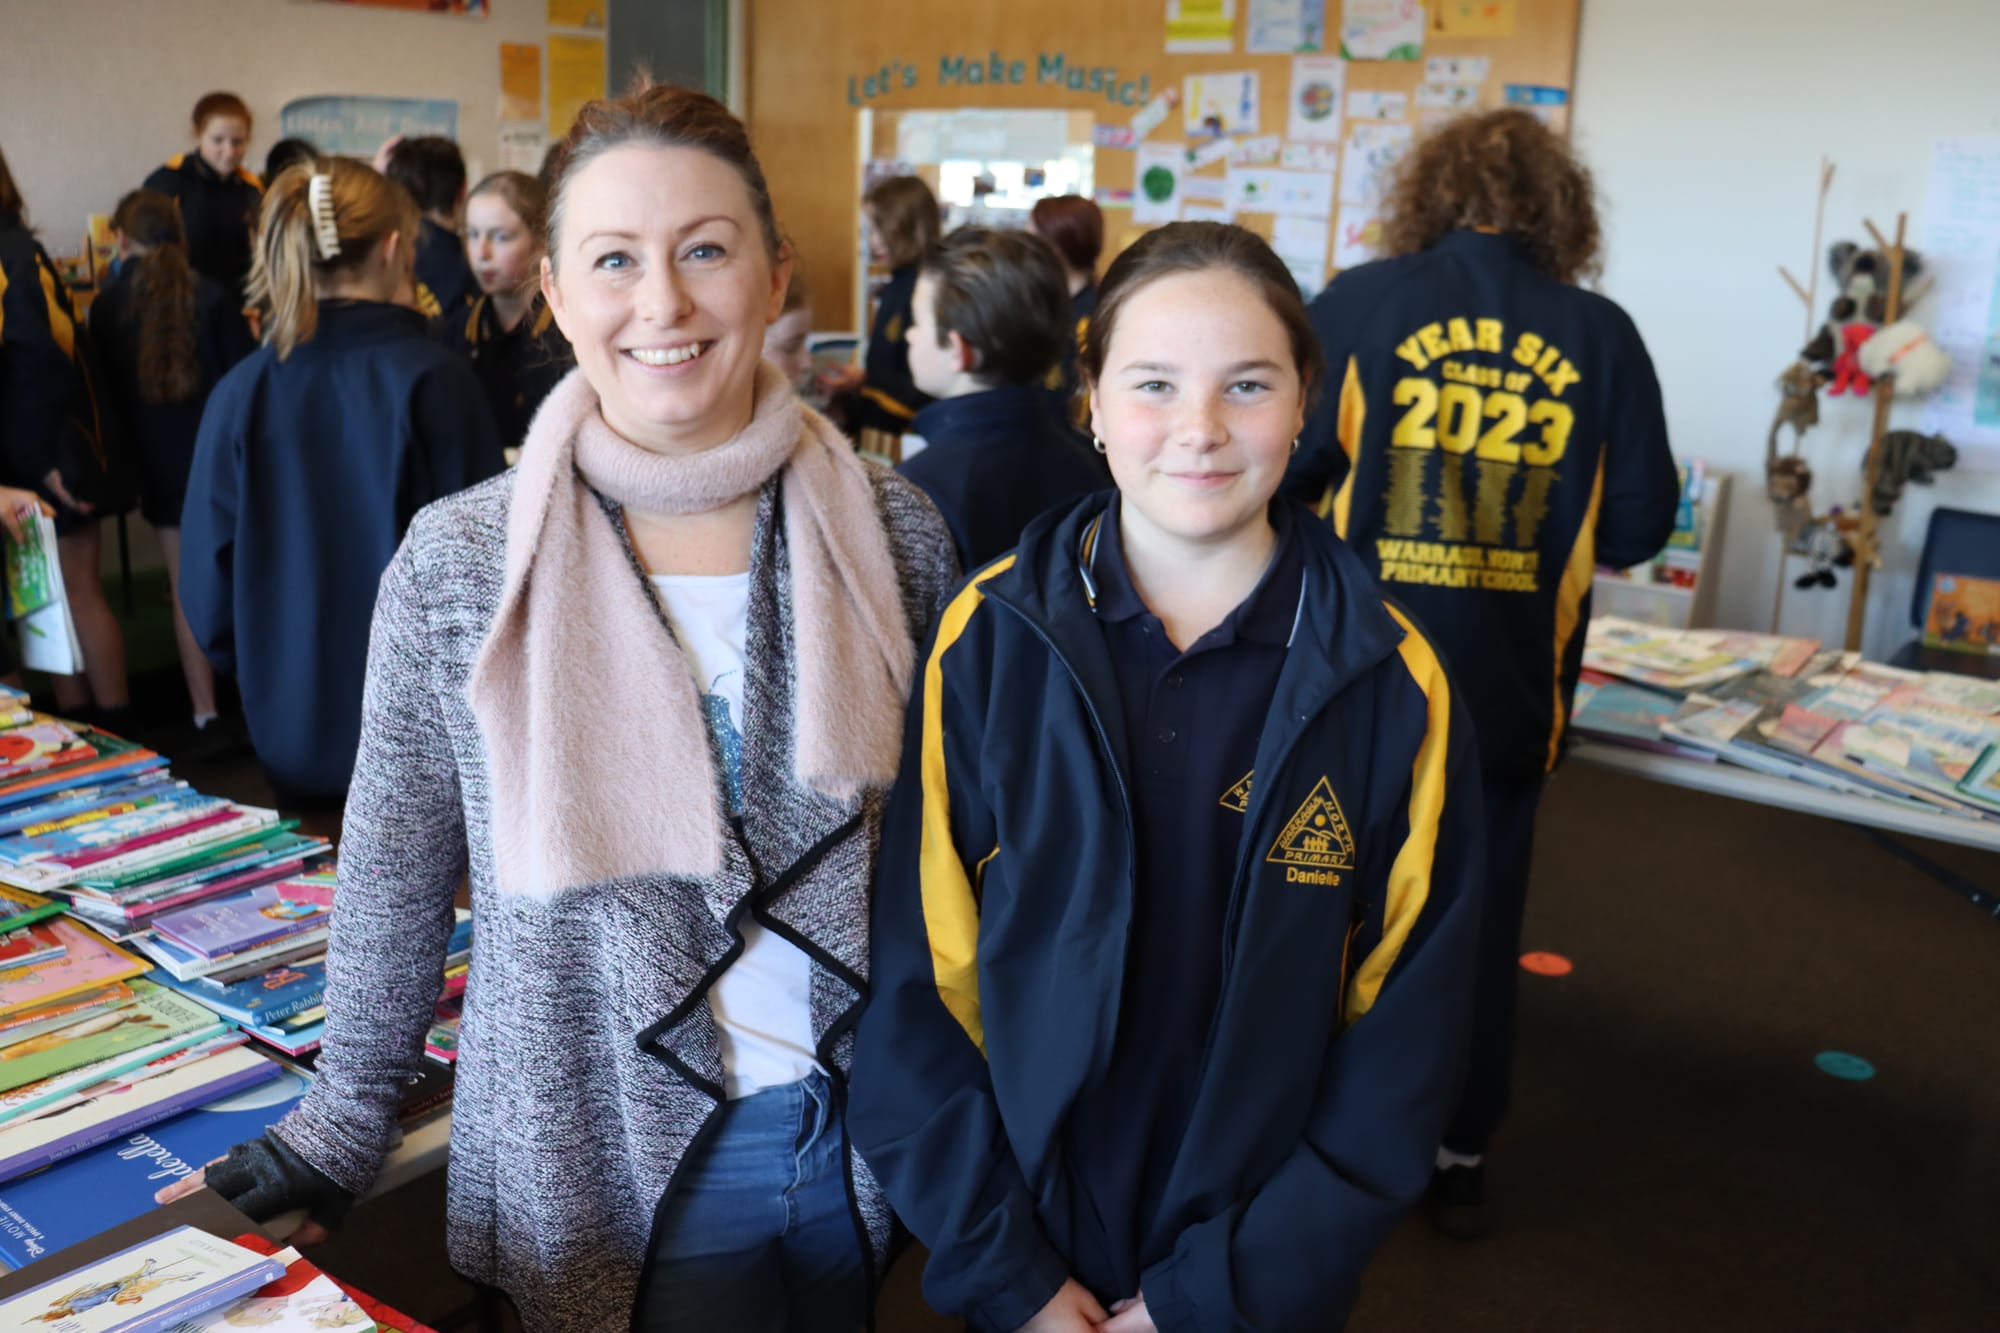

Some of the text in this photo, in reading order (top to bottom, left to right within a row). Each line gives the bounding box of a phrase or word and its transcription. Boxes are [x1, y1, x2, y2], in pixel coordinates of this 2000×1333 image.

[847, 51, 1150, 107] Let's Make Music!
[1395, 317, 1581, 397] YEAR SIX
[1442, 360, 1532, 393] CLASS OF
[1391, 377, 1575, 467] 2023
[1284, 850, 1346, 866] PRIMARY
[1286, 866, 1341, 886] Danielle
[264, 992, 323, 1023] Peter Rabbit
[117, 1132, 198, 1181] derella
